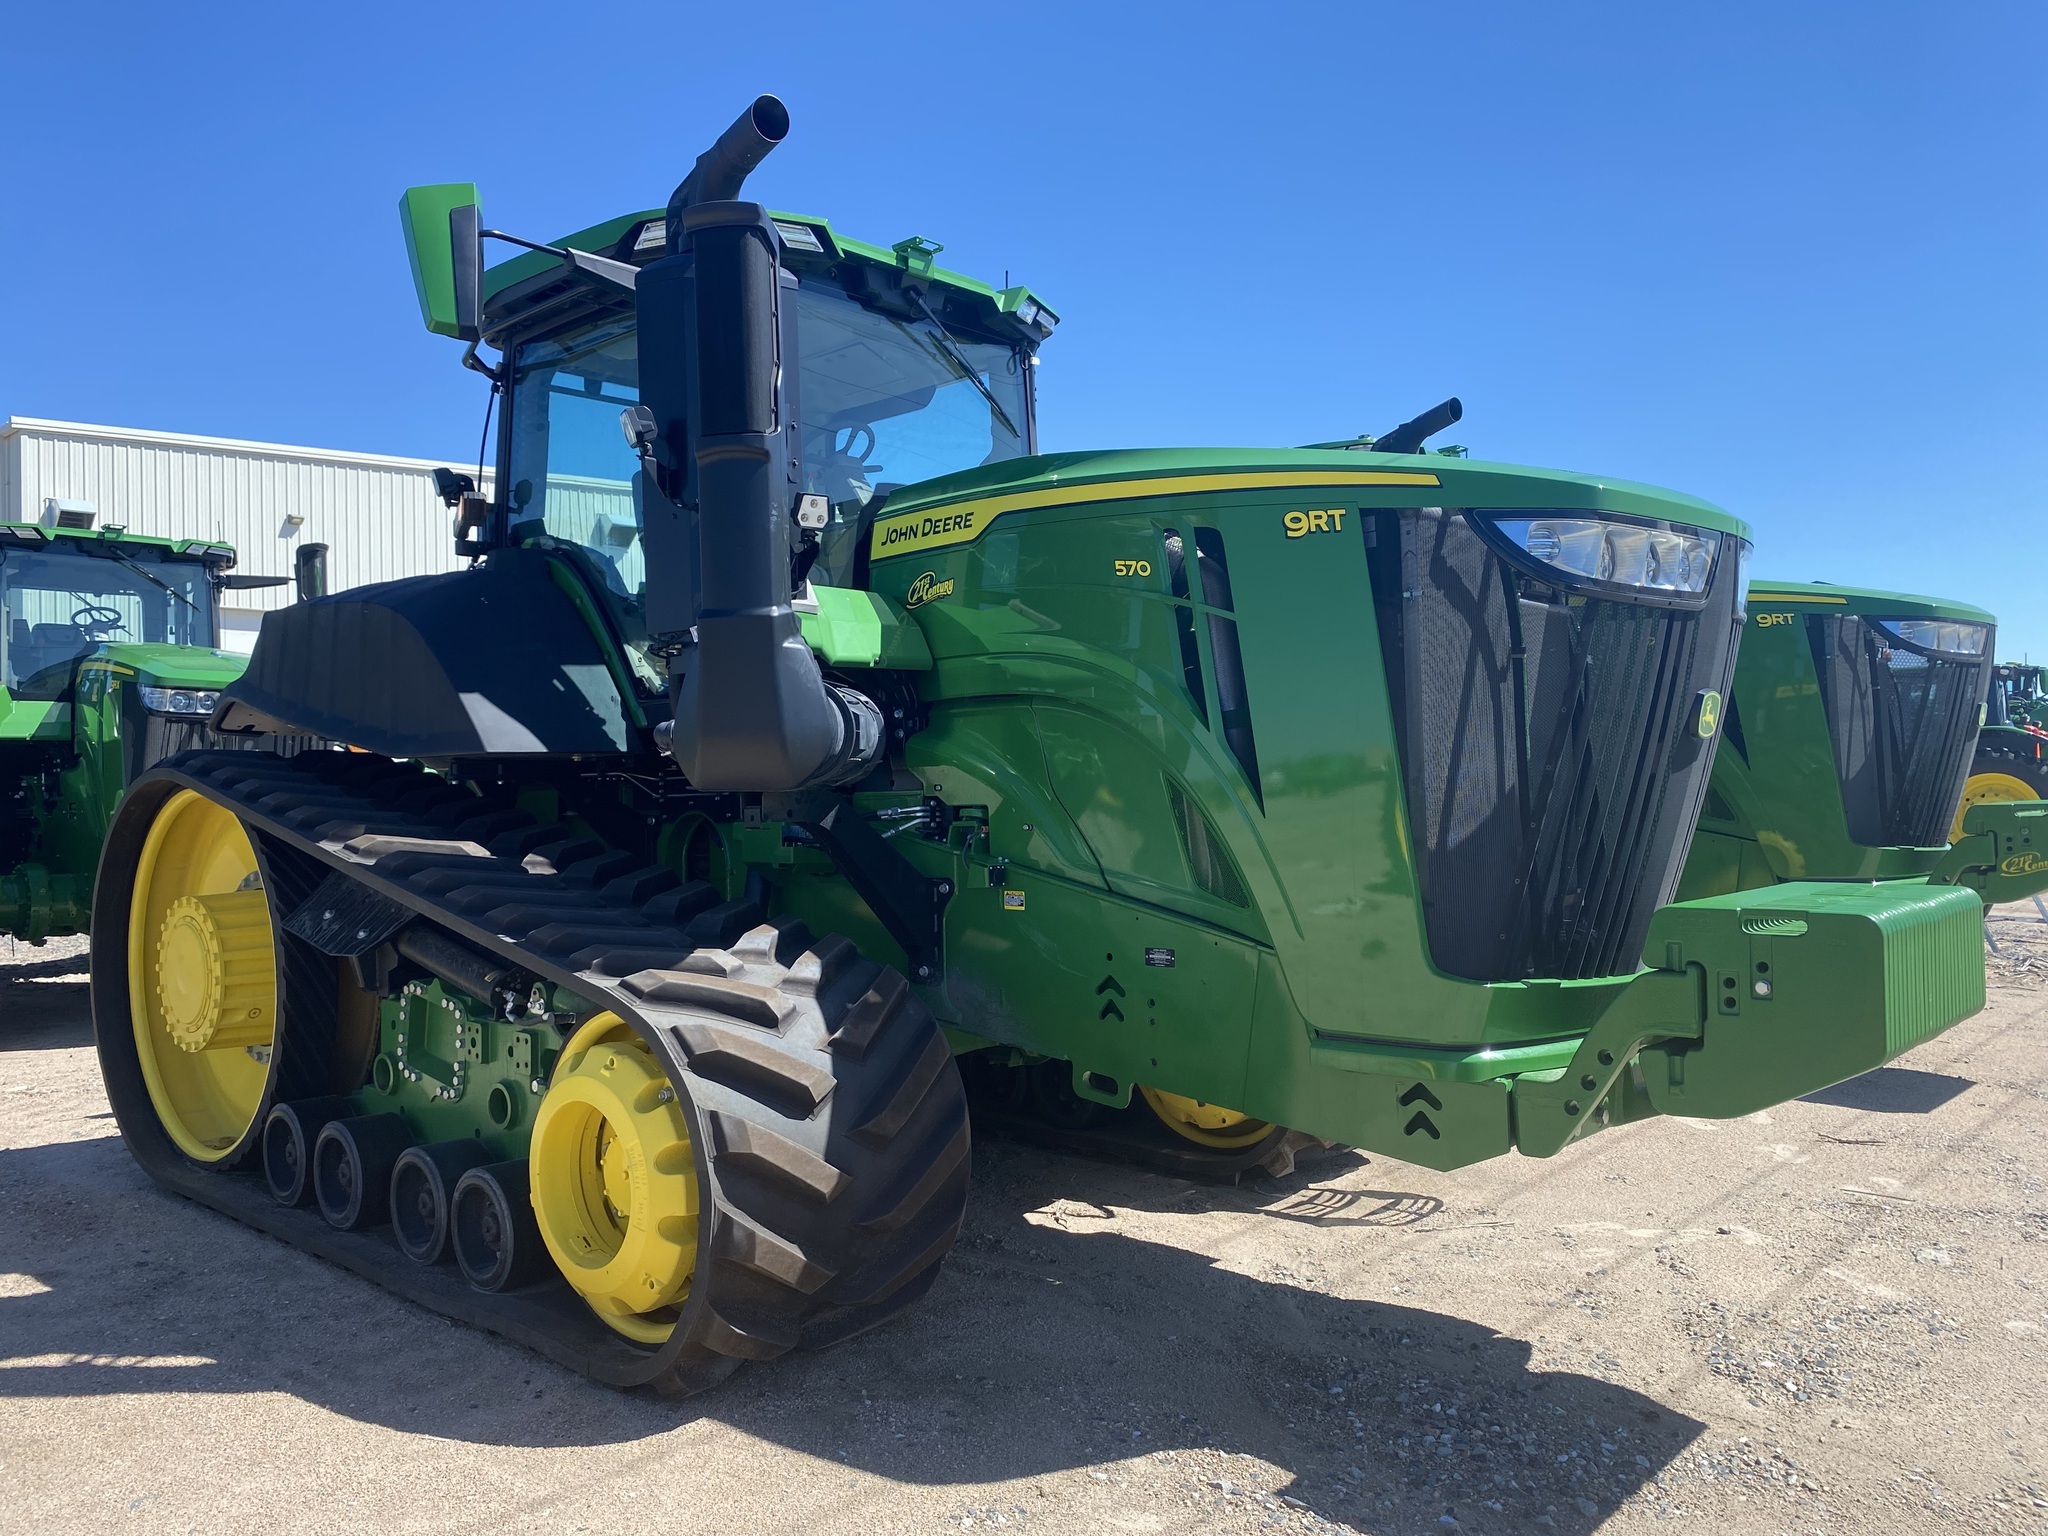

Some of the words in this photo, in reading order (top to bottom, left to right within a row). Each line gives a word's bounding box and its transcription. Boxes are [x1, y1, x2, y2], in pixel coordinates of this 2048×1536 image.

[881, 523, 919, 546] JOHN
[921, 512, 974, 537] DEERE
[1283, 509, 1346, 538] 9RT
[1115, 560, 1151, 576] 570
[1756, 613, 1795, 628] 9RT
